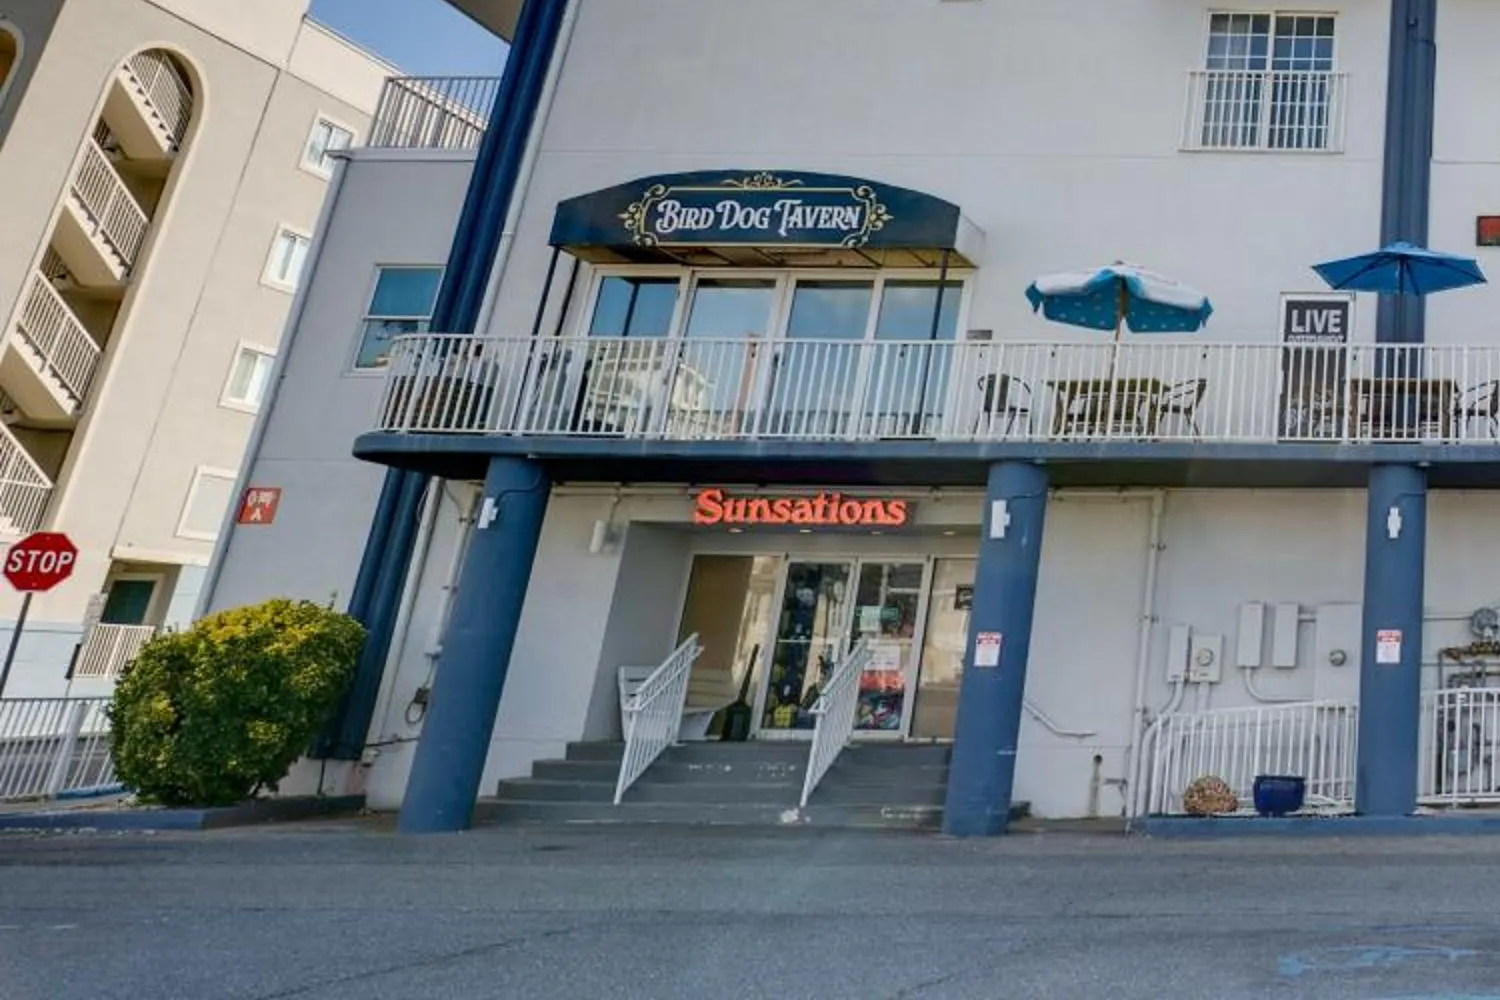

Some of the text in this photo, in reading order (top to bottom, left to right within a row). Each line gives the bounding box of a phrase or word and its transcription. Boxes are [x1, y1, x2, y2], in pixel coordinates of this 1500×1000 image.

[1291, 309, 1343, 333] LIVE
[694, 488, 905, 524] Sunsations
[7, 549, 74, 574] STOP
